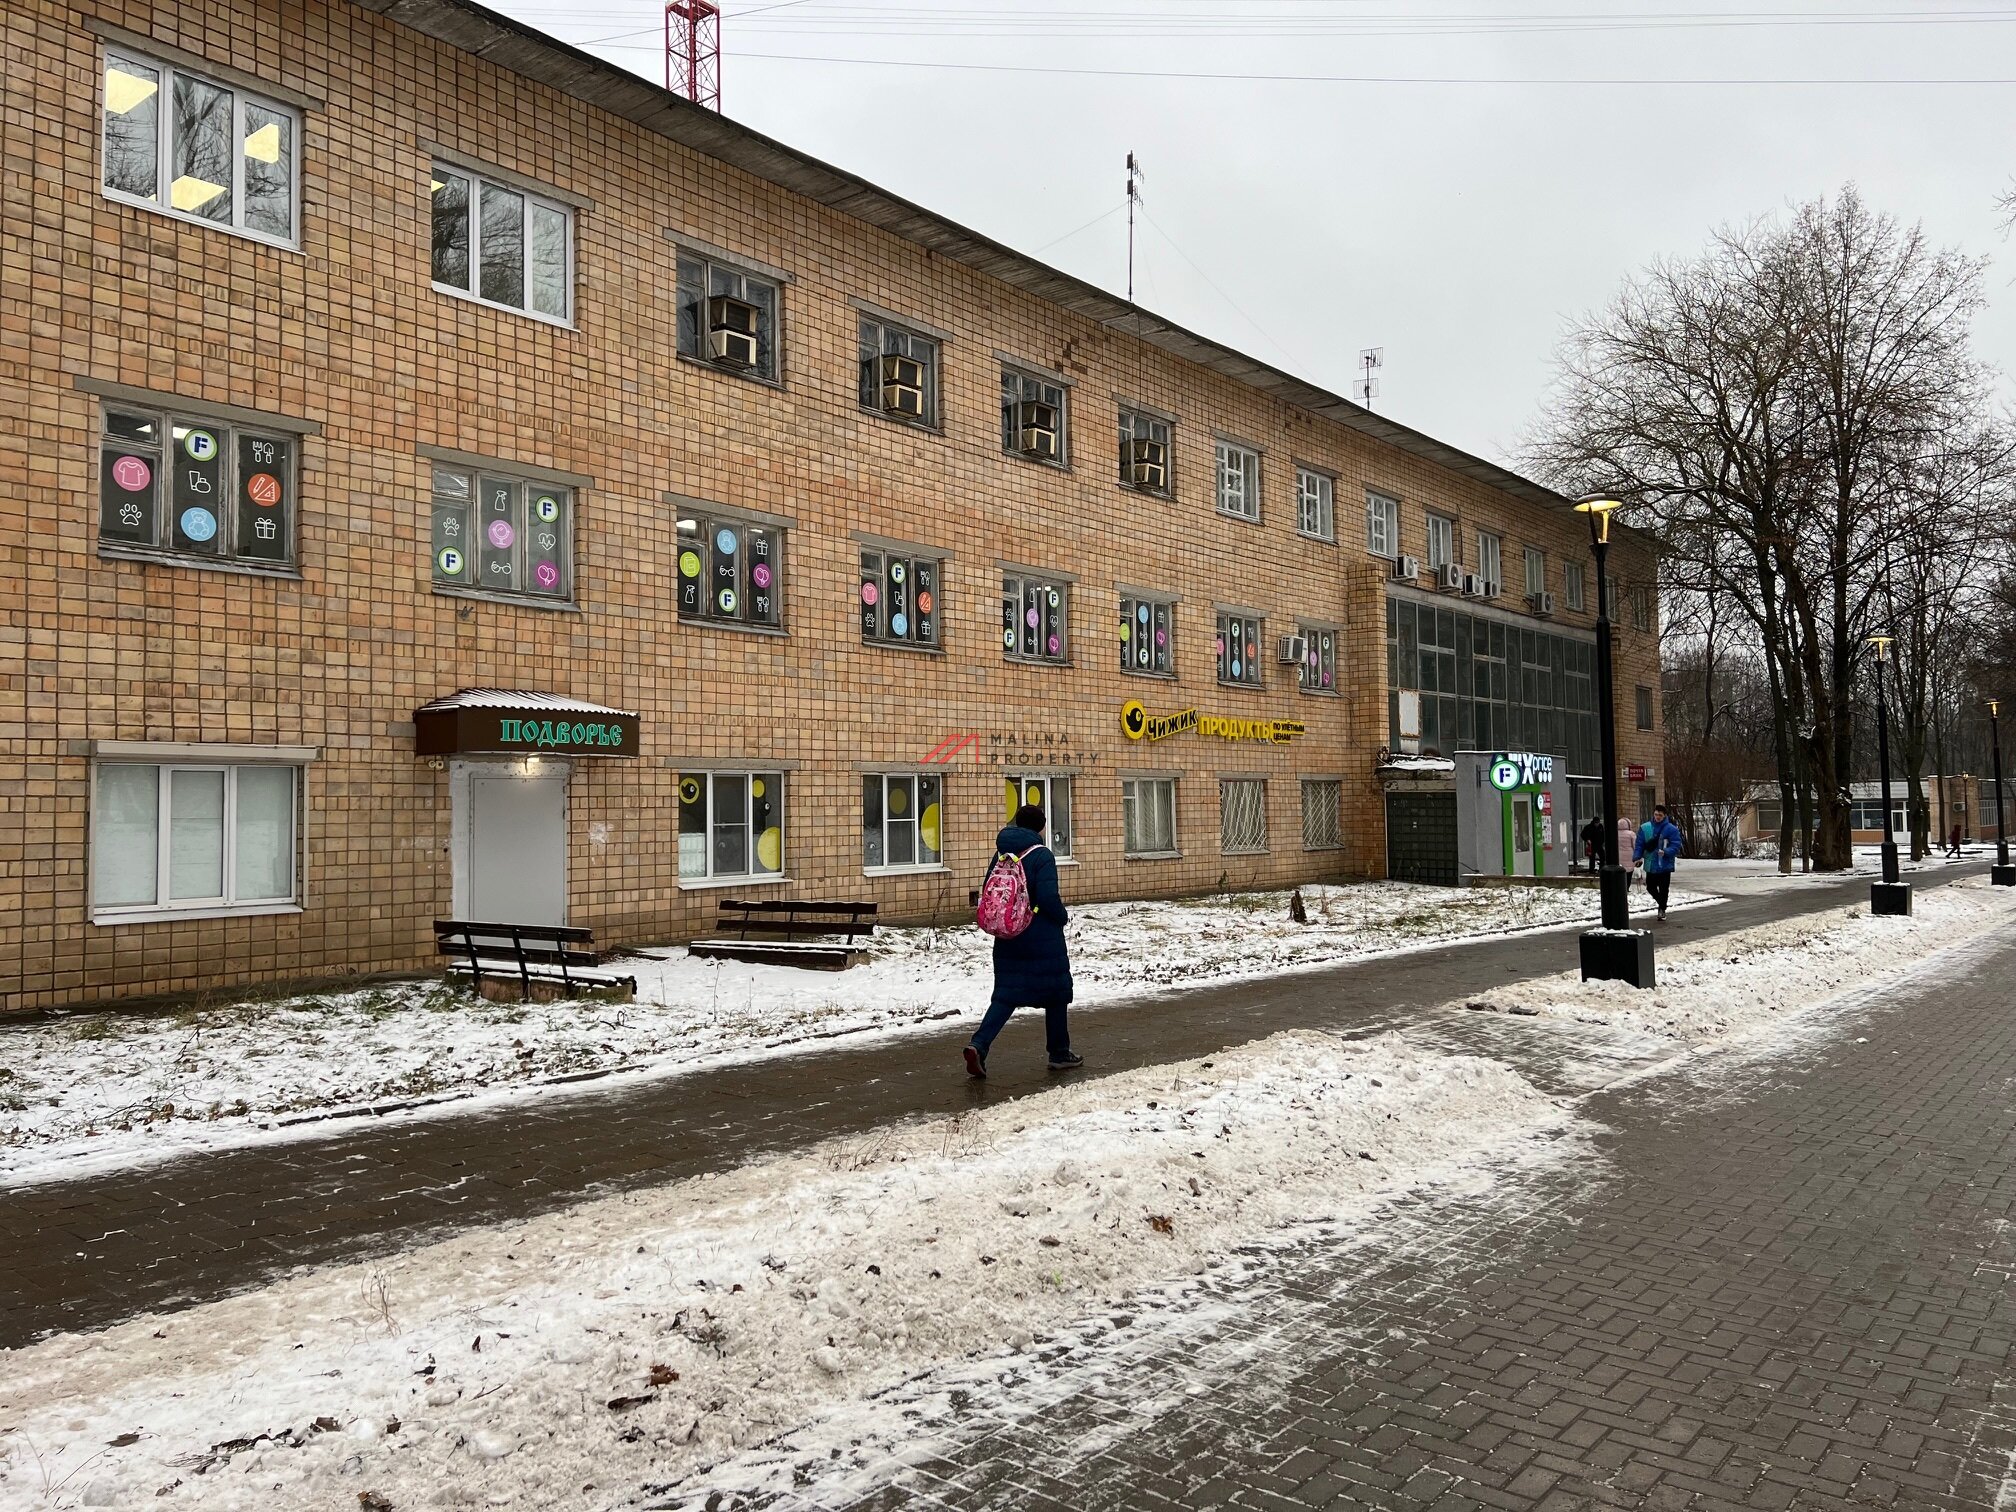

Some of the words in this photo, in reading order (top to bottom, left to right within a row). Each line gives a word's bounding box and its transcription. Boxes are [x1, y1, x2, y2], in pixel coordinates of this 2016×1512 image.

[194, 436, 208, 453] F
[542, 502, 552, 516] F
[445, 553, 456, 568] F
[1147, 709, 1198, 740] ЧИЖИК
[1199, 717, 1270, 740] ПРОДУКТЫ
[500, 719, 623, 748] ПОДВОРЬЕ
[1499, 768, 1511, 783] F
